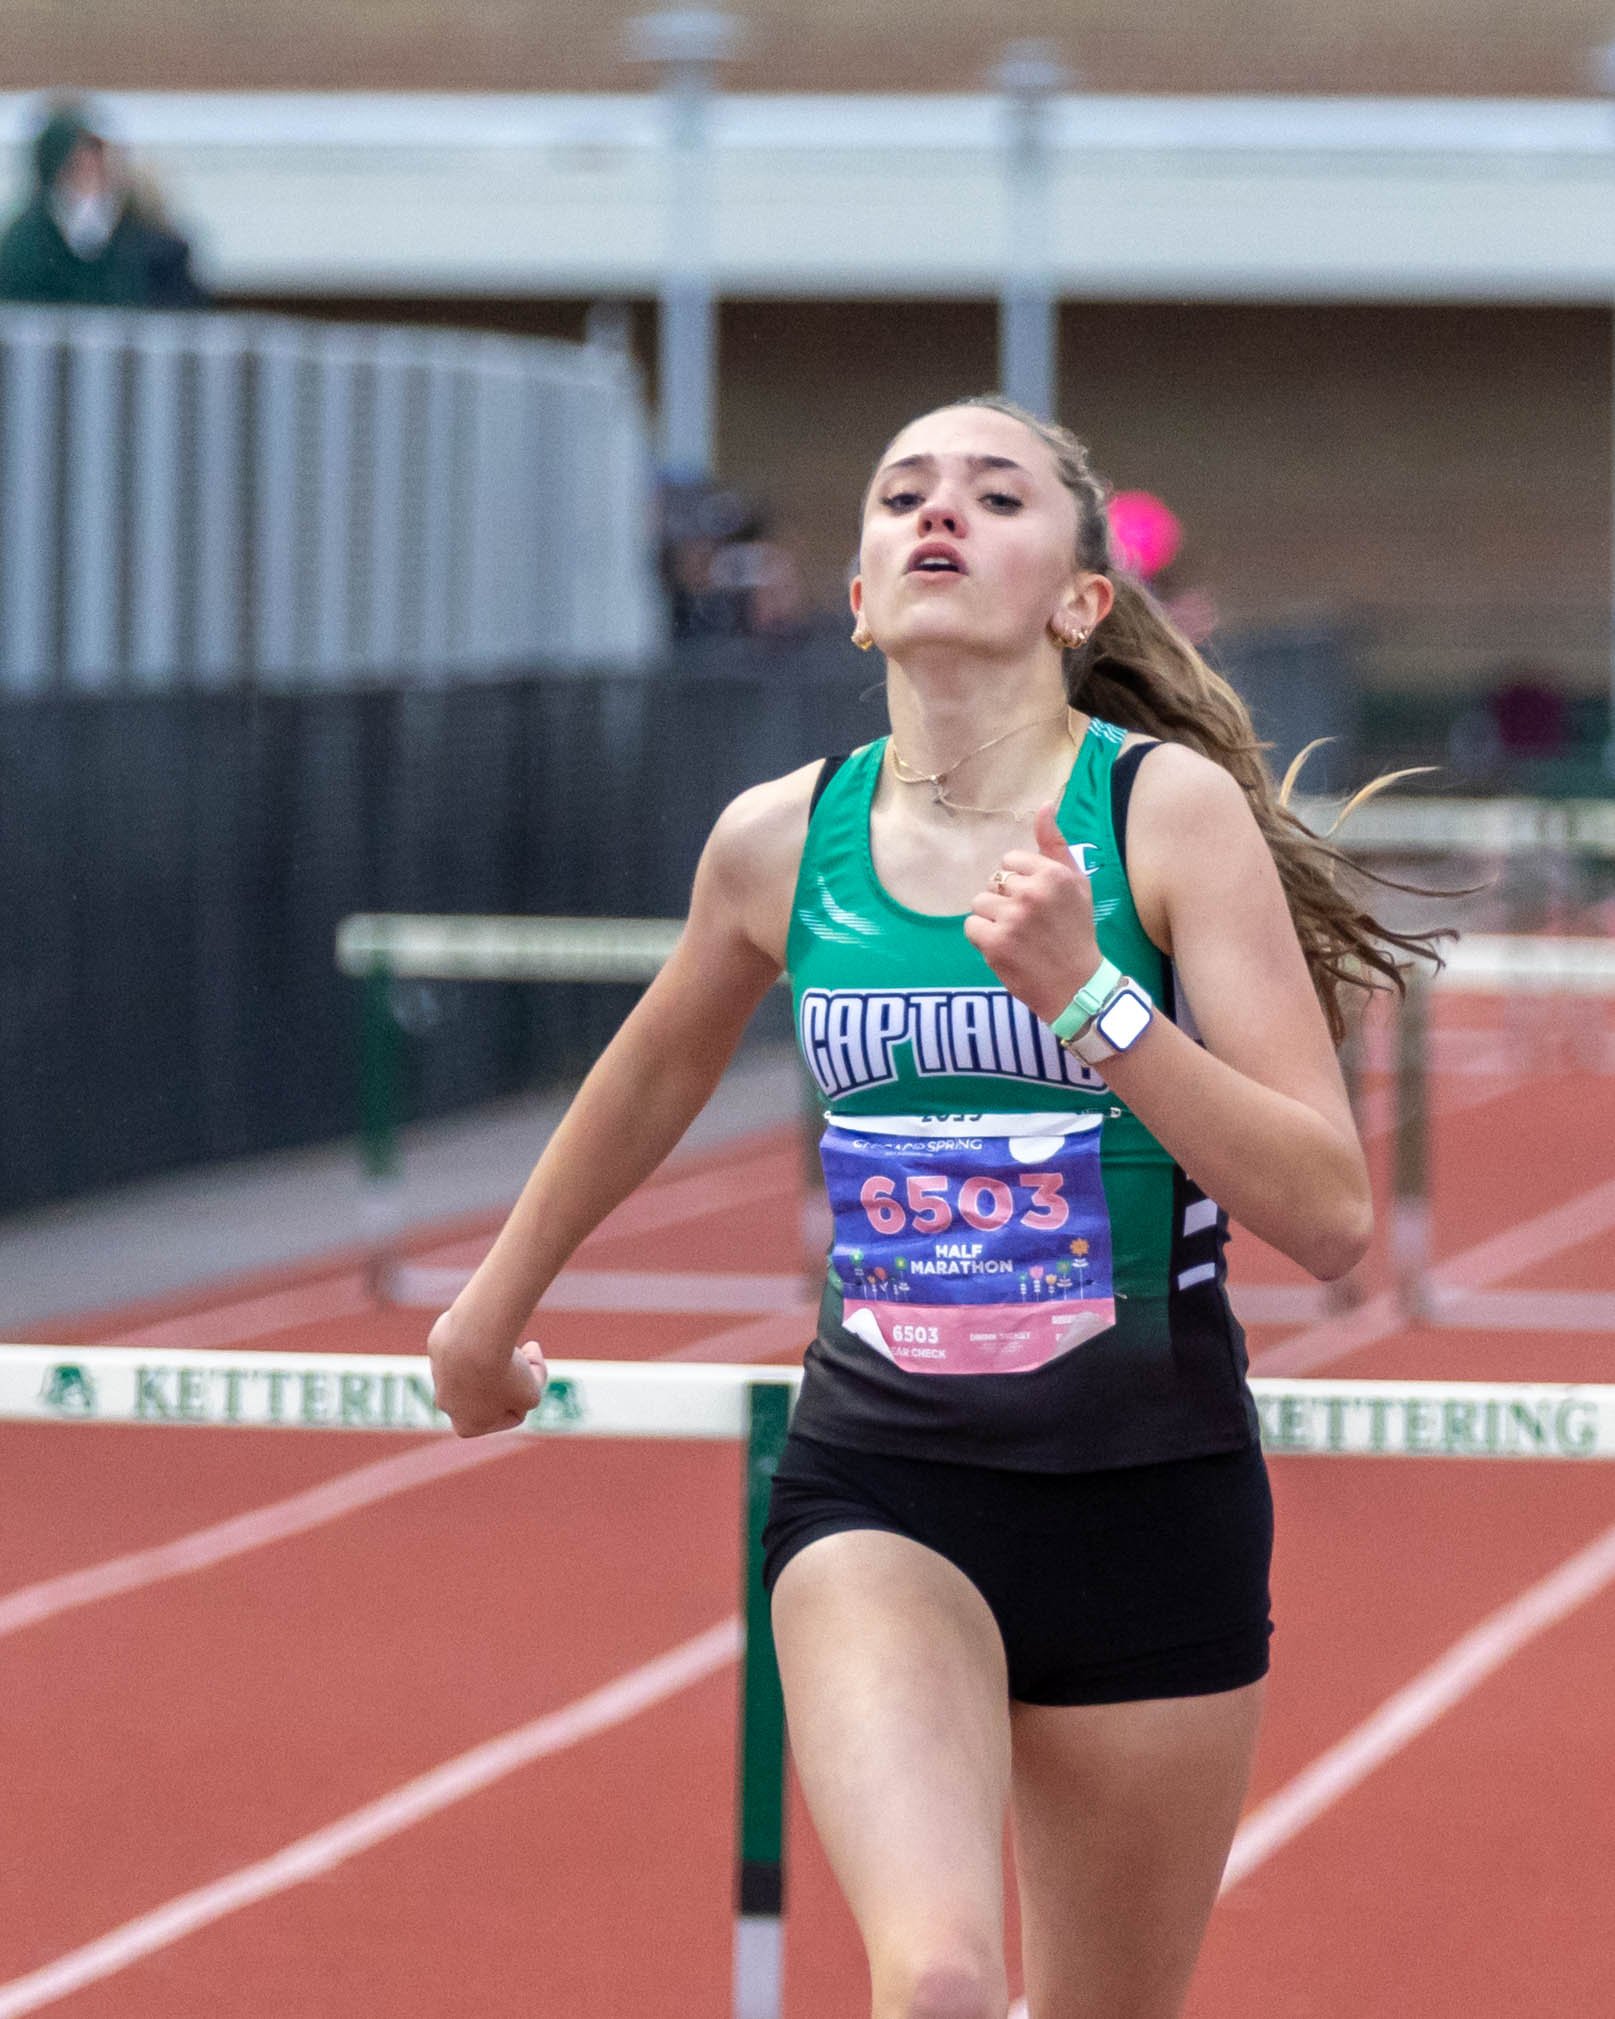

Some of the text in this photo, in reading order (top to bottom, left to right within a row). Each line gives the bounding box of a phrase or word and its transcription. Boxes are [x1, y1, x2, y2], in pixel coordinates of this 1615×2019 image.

[860, 1172, 1070, 1235] 6503
[935, 1244, 983, 1259] HALF
[910, 1259, 1014, 1275] MARATHON
[892, 1325, 940, 1344] 6503
[134, 1365, 448, 1425] KETTERIN
